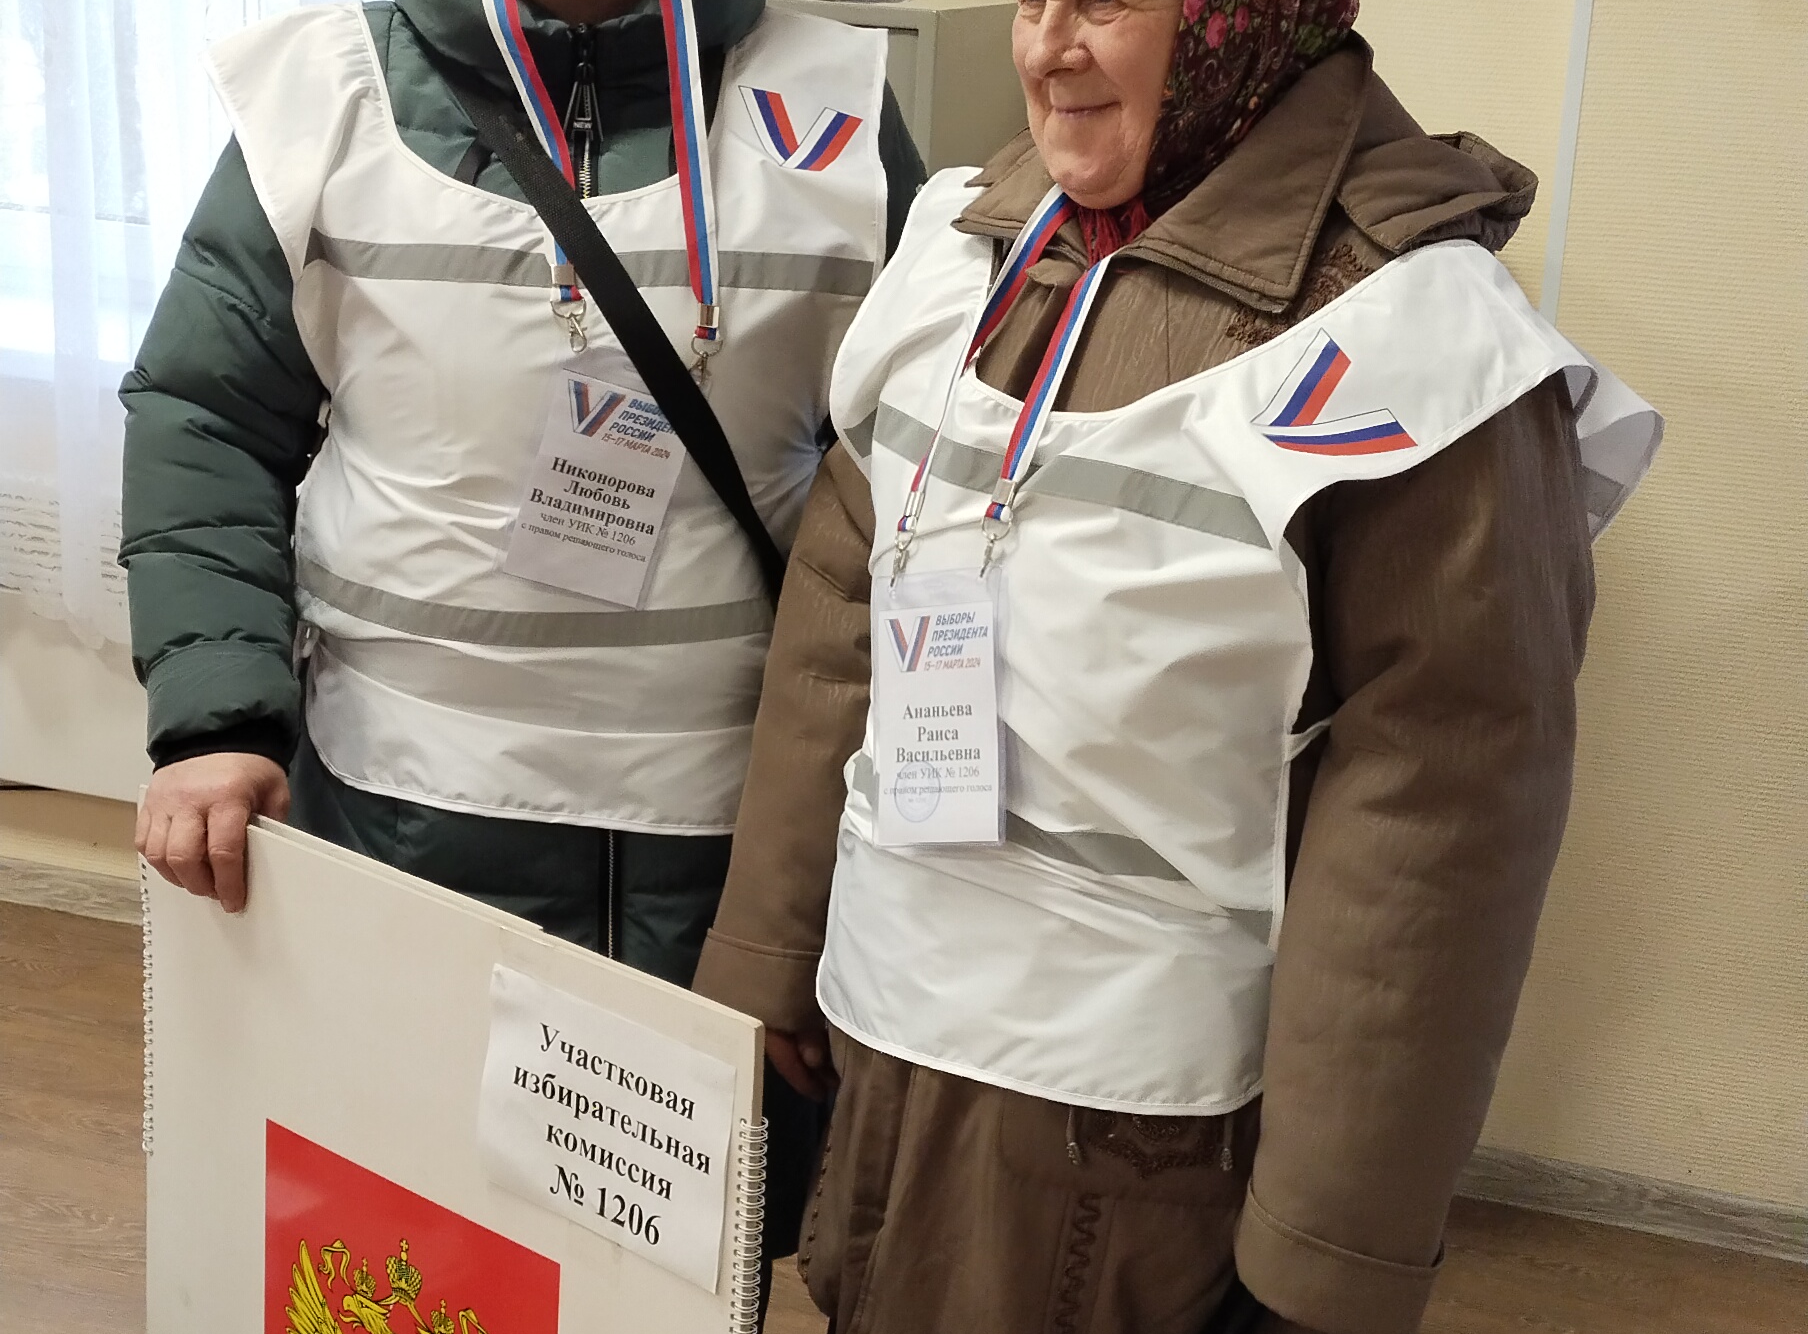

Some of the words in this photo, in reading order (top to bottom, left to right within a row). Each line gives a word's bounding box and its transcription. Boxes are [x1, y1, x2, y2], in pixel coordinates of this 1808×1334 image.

[628, 398, 663, 416] ВЫБО
[609, 422, 656, 442] РОССИИ
[625, 439, 652, 454] МАРТА
[551, 457, 656, 498] Никонорова
[563, 479, 631, 510] Любовь
[530, 488, 655, 535] Владимировна
[540, 512, 565, 526] член
[568, 518, 594, 534] УИК
[595, 527, 609, 539] №
[611, 530, 636, 546] 1206
[528, 524, 562, 539] правом
[561, 533, 616, 554] решающего
[616, 548, 647, 563] голоса
[935, 611, 976, 626] ВЫБОРЫ
[931, 626, 989, 642] ПРЕЗИДЕНТА
[927, 644, 964, 658] РОССИИ
[943, 658, 964, 670] МАРТА
[964, 657, 981, 668] 2024
[903, 703, 973, 720] Ананьева
[917, 726, 959, 742] Раиса
[896, 747, 981, 763] Васильевна
[920, 767, 942, 779] УИК
[945, 766, 956, 778] №
[958, 766, 980, 778] 1206
[540, 1022, 695, 1121] Участковая
[513, 1065, 711, 1175] избирательная
[546, 1123, 672, 1201] комиссия
[549, 1164, 584, 1207] №
[595, 1187, 662, 1245] 1206
